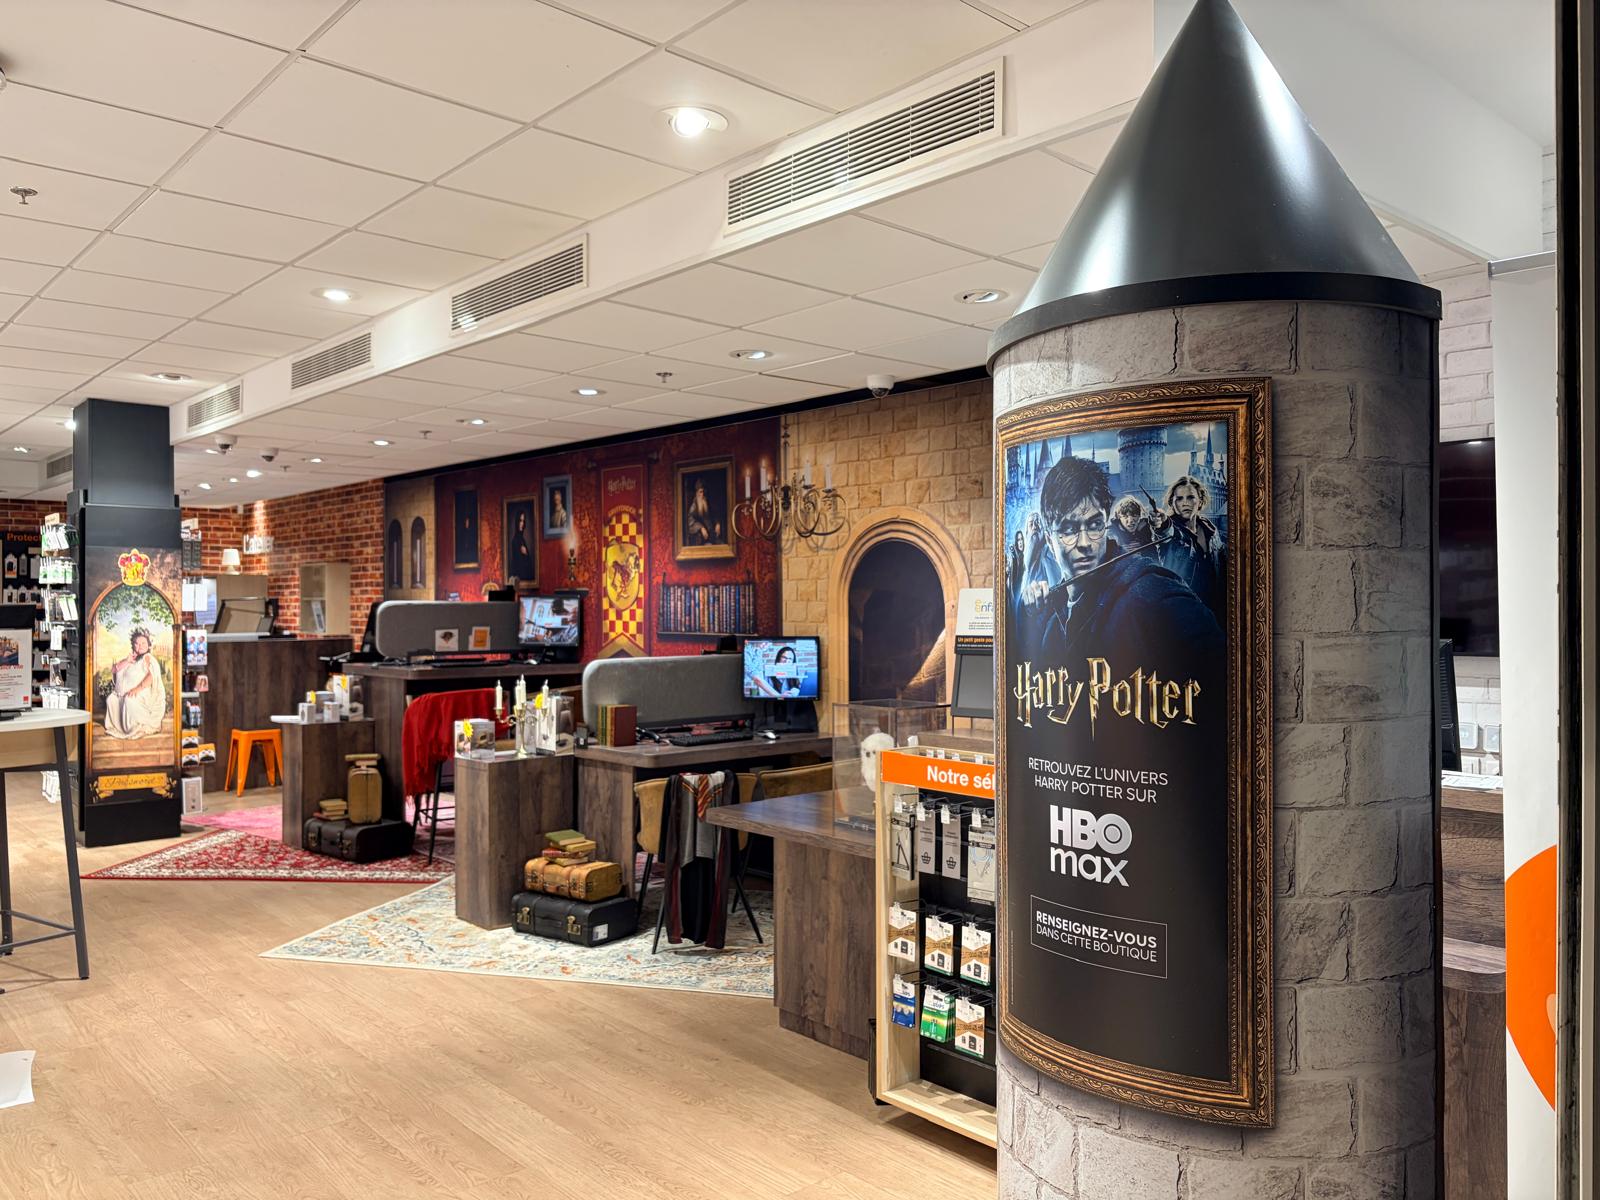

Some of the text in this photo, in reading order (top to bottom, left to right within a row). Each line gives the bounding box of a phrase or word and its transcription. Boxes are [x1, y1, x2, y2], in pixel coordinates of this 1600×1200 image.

[1013, 657, 1201, 741] Harry Potter
[927, 764, 969, 787] Notre
[1028, 756, 1169, 786] RETROUVEZ L'UNIVERS
[1034, 774, 1157, 803] HARRY POTTER SUR
[1049, 804, 1133, 855] HBO
[1049, 847, 1130, 887] max
[1036, 910, 1157, 949] RENSEIGNEZ-VOUS
[1036, 923, 1158, 962] DANS CETTE BOUTIQUE
